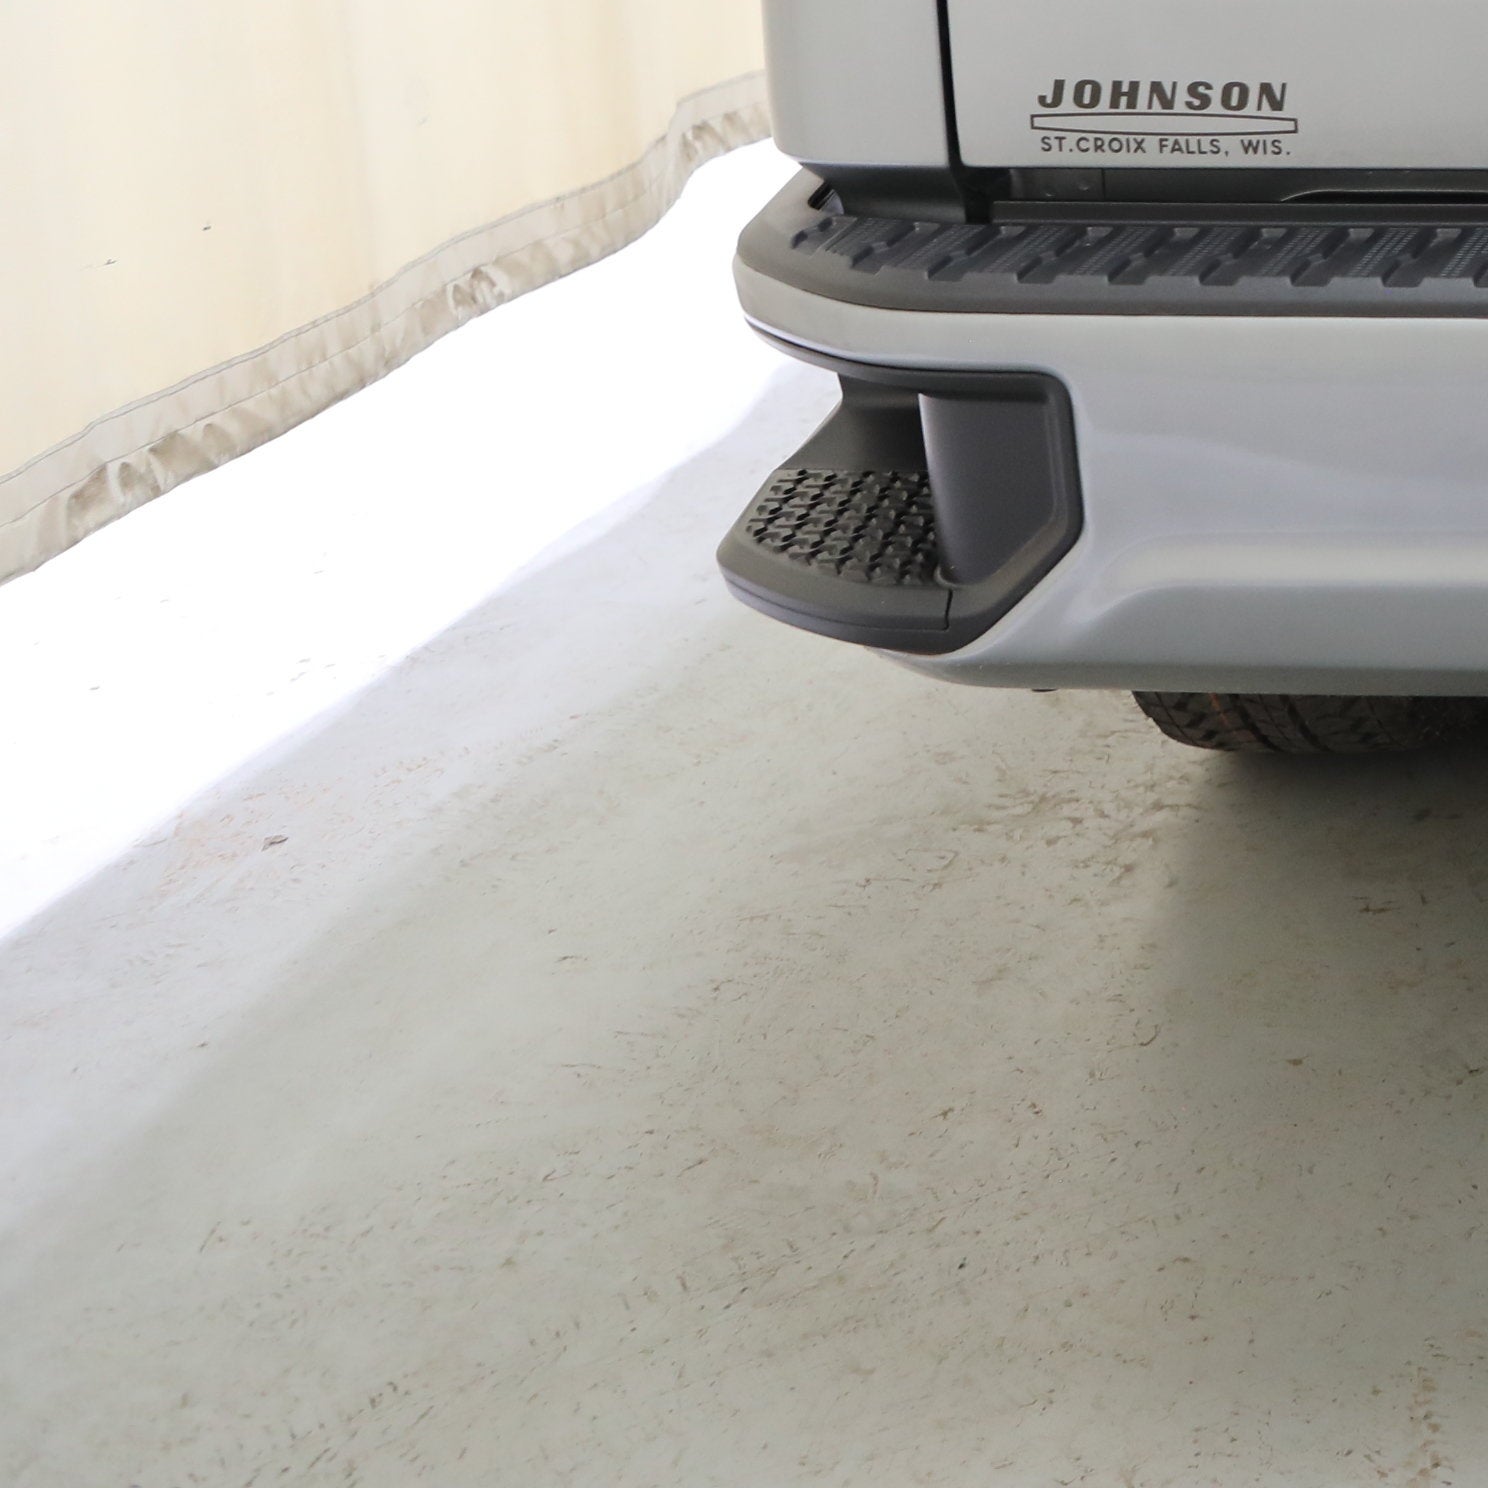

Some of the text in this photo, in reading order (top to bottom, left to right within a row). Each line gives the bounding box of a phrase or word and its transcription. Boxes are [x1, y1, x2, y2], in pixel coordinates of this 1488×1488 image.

[1037, 78, 1288, 112] JOHNSON
[1158, 137, 1230, 157] FALLS,
[1240, 139, 1292, 156] WIS.
